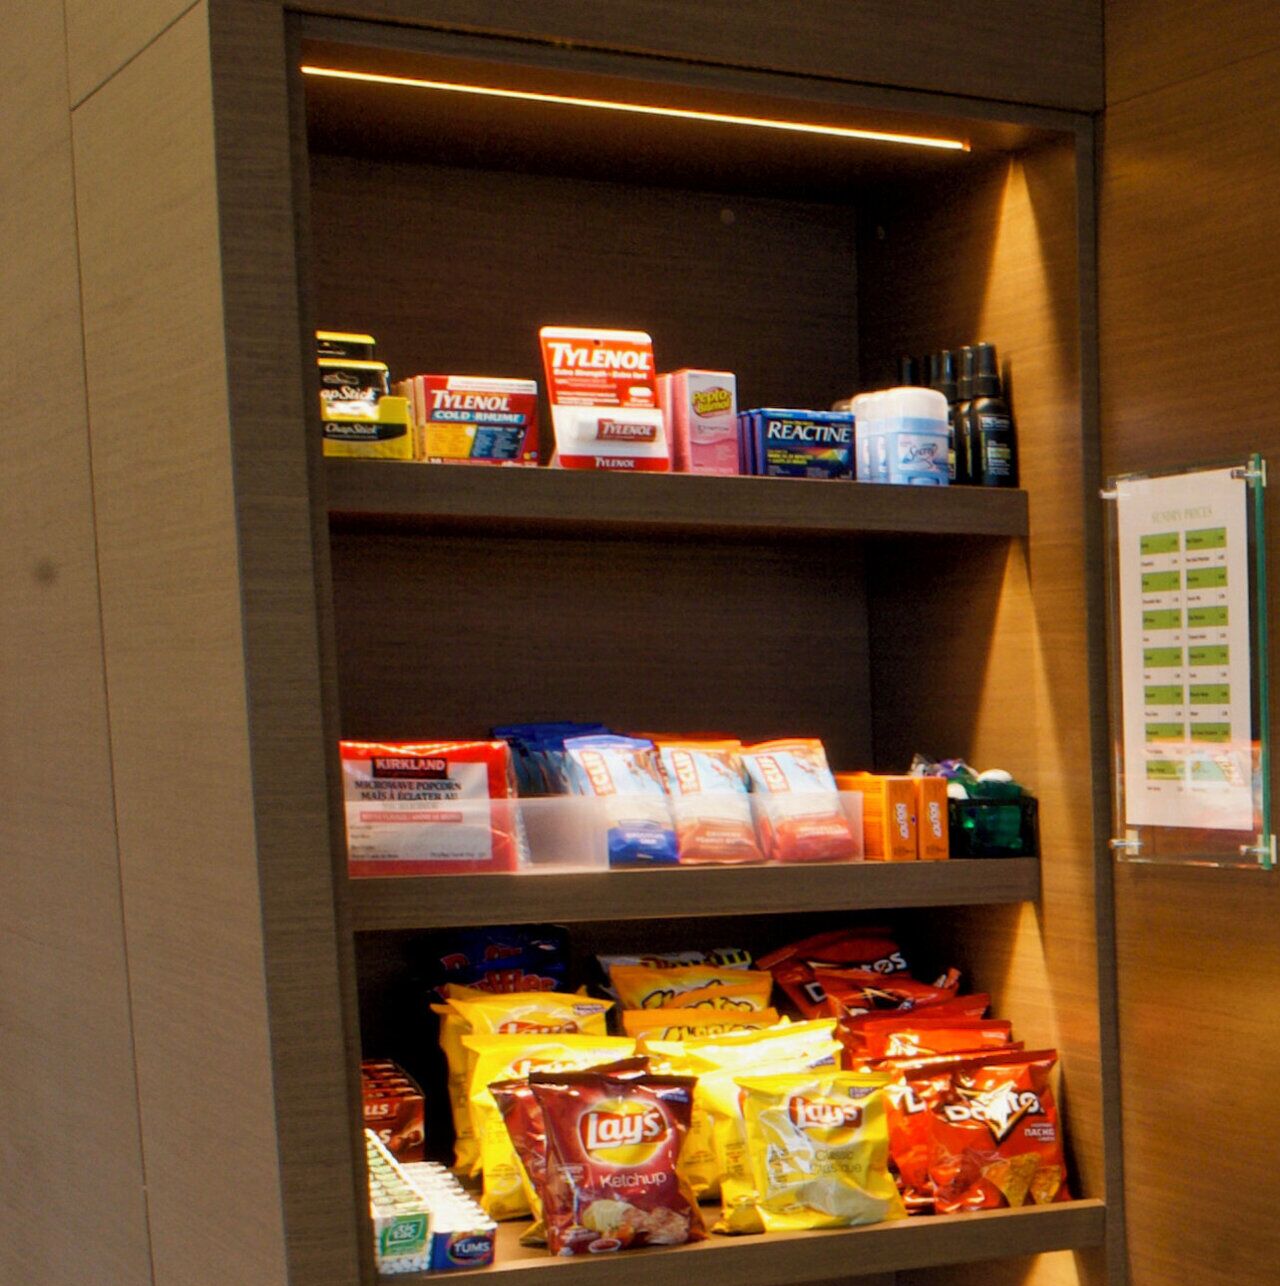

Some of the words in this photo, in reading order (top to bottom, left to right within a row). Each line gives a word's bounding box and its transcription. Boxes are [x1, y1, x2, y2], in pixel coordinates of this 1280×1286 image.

[548, 342, 651, 370] TYLENOL
[430, 389, 511, 411] TYLENOL
[434, 411, 469, 422] COLD
[602, 423, 652, 436] TYLENOL
[767, 421, 850, 444] REACTINE
[594, 457, 635, 468] TYLENOL
[376, 759, 446, 771] KIRKLAND
[416, 782, 462, 791] POPCORN
[587, 1109, 660, 1150] Lay's
[600, 1171, 668, 1189] Ketchup
[454, 1241, 491, 1253] TUMS
